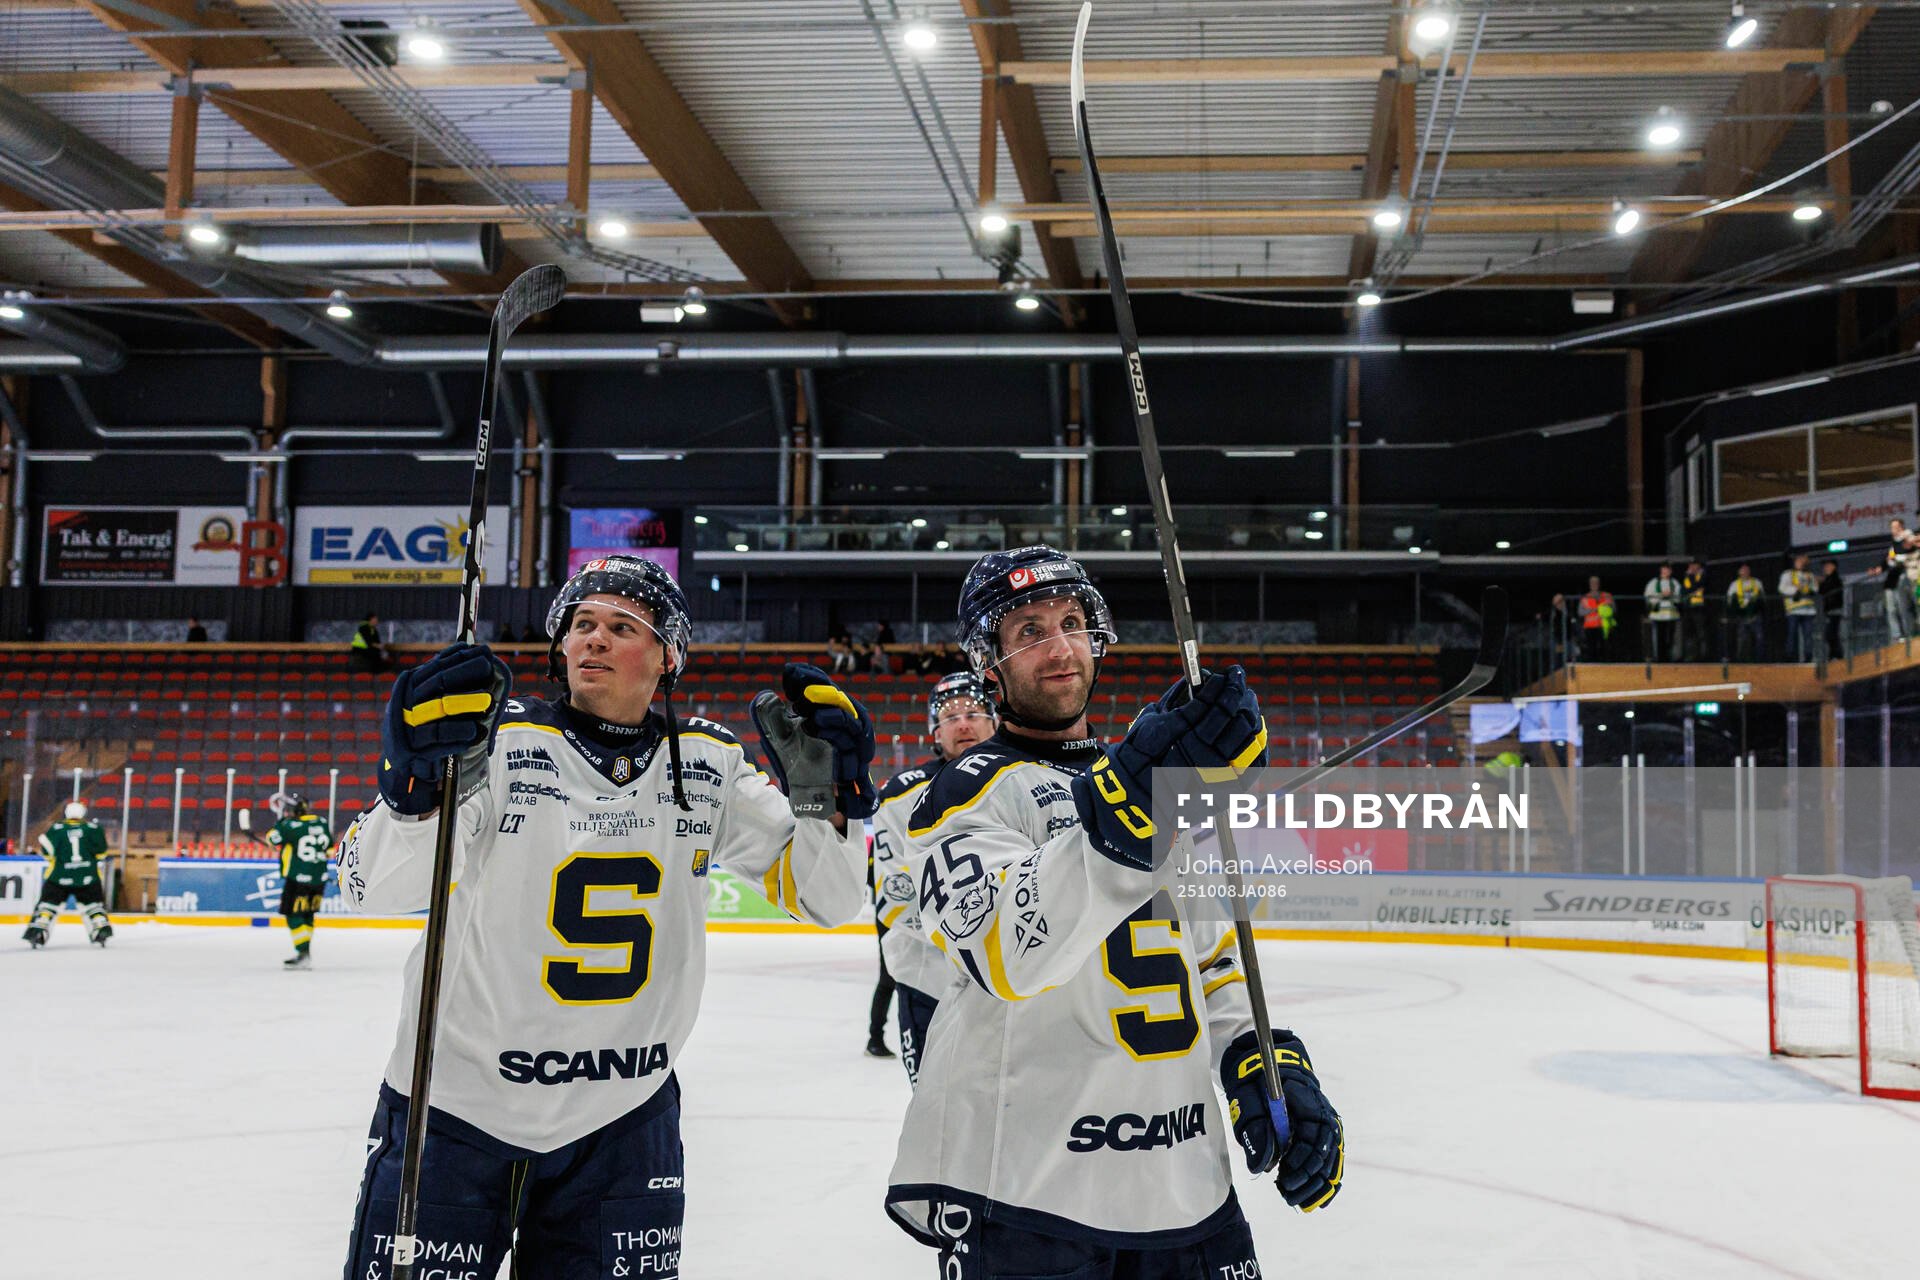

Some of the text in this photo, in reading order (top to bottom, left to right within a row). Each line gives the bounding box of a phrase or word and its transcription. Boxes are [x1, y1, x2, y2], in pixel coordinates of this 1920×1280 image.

[1127, 354, 1149, 412] CCM
[476, 422, 490, 468] CCM
[59, 528, 171, 550] Tak & Energi
[1031, 563, 1071, 575] SVENSKA
[1034, 571, 1057, 583] SPEL
[524, 796, 537, 806] AB
[795, 803, 823, 812] CCM
[498, 813, 526, 834] LT
[67, 829, 83, 862] 1
[919, 833, 985, 915] 45
[1376, 902, 1512, 926] ÖIKBILJETT.SE
[1533, 890, 1730, 917] SANDBERGS
[540, 851, 664, 1006] S
[499, 1043, 669, 1085] SCANIA
[1066, 1103, 1207, 1153] SCANIA
[1242, 1130, 1257, 1156] CCM
[647, 1177, 682, 1189] CCM
[366, 1260, 382, 1280] &
[613, 1250, 680, 1277] & FUCHS
